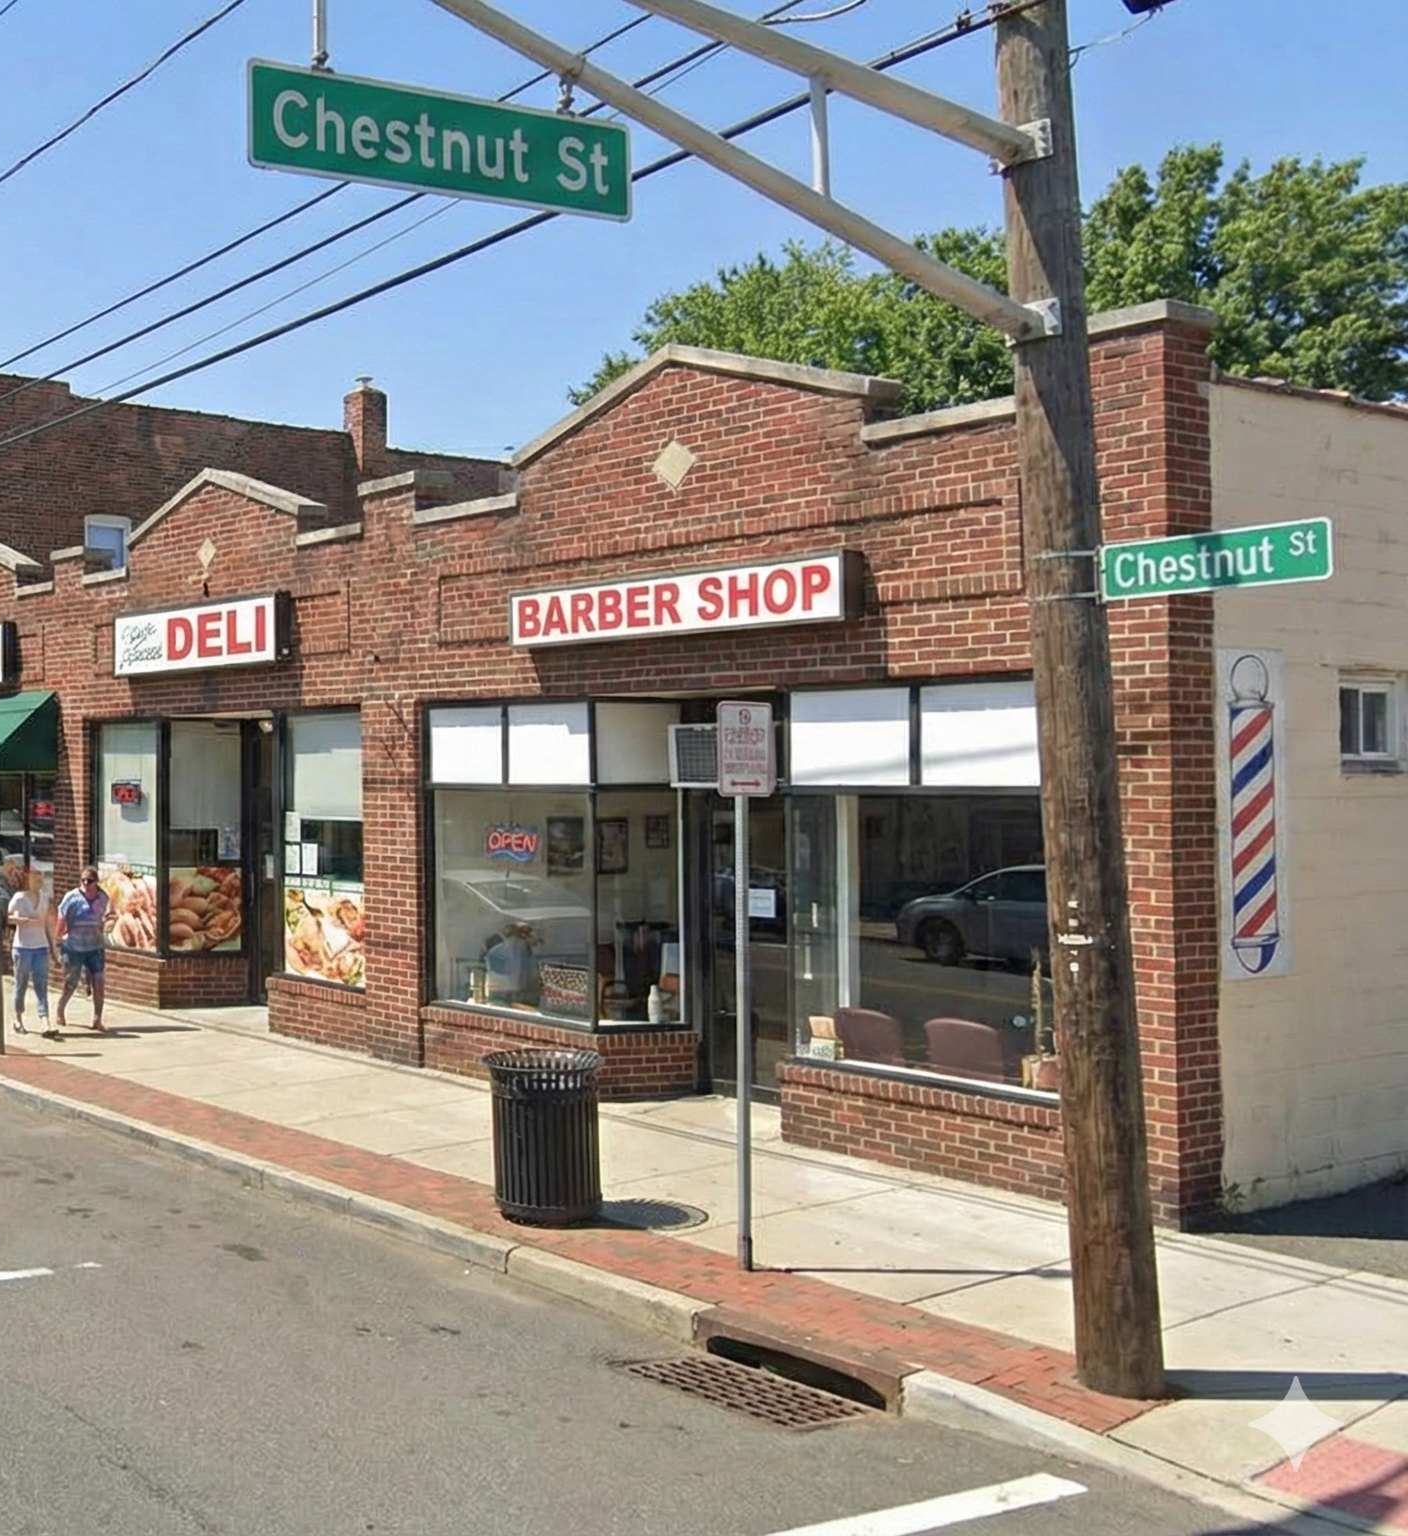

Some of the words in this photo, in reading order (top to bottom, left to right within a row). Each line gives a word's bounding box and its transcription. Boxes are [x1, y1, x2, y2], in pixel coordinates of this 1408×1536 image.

[273, 90, 529, 182] Chestnut
[556, 136, 609, 195] St
[1115, 536, 1274, 587] Chestnut
[1289, 530, 1316, 556] St
[518, 582, 682, 638] BARBER
[697, 565, 831, 620] SHOP
[167, 605, 266, 661] DELI
[489, 832, 537, 852] OPEN
